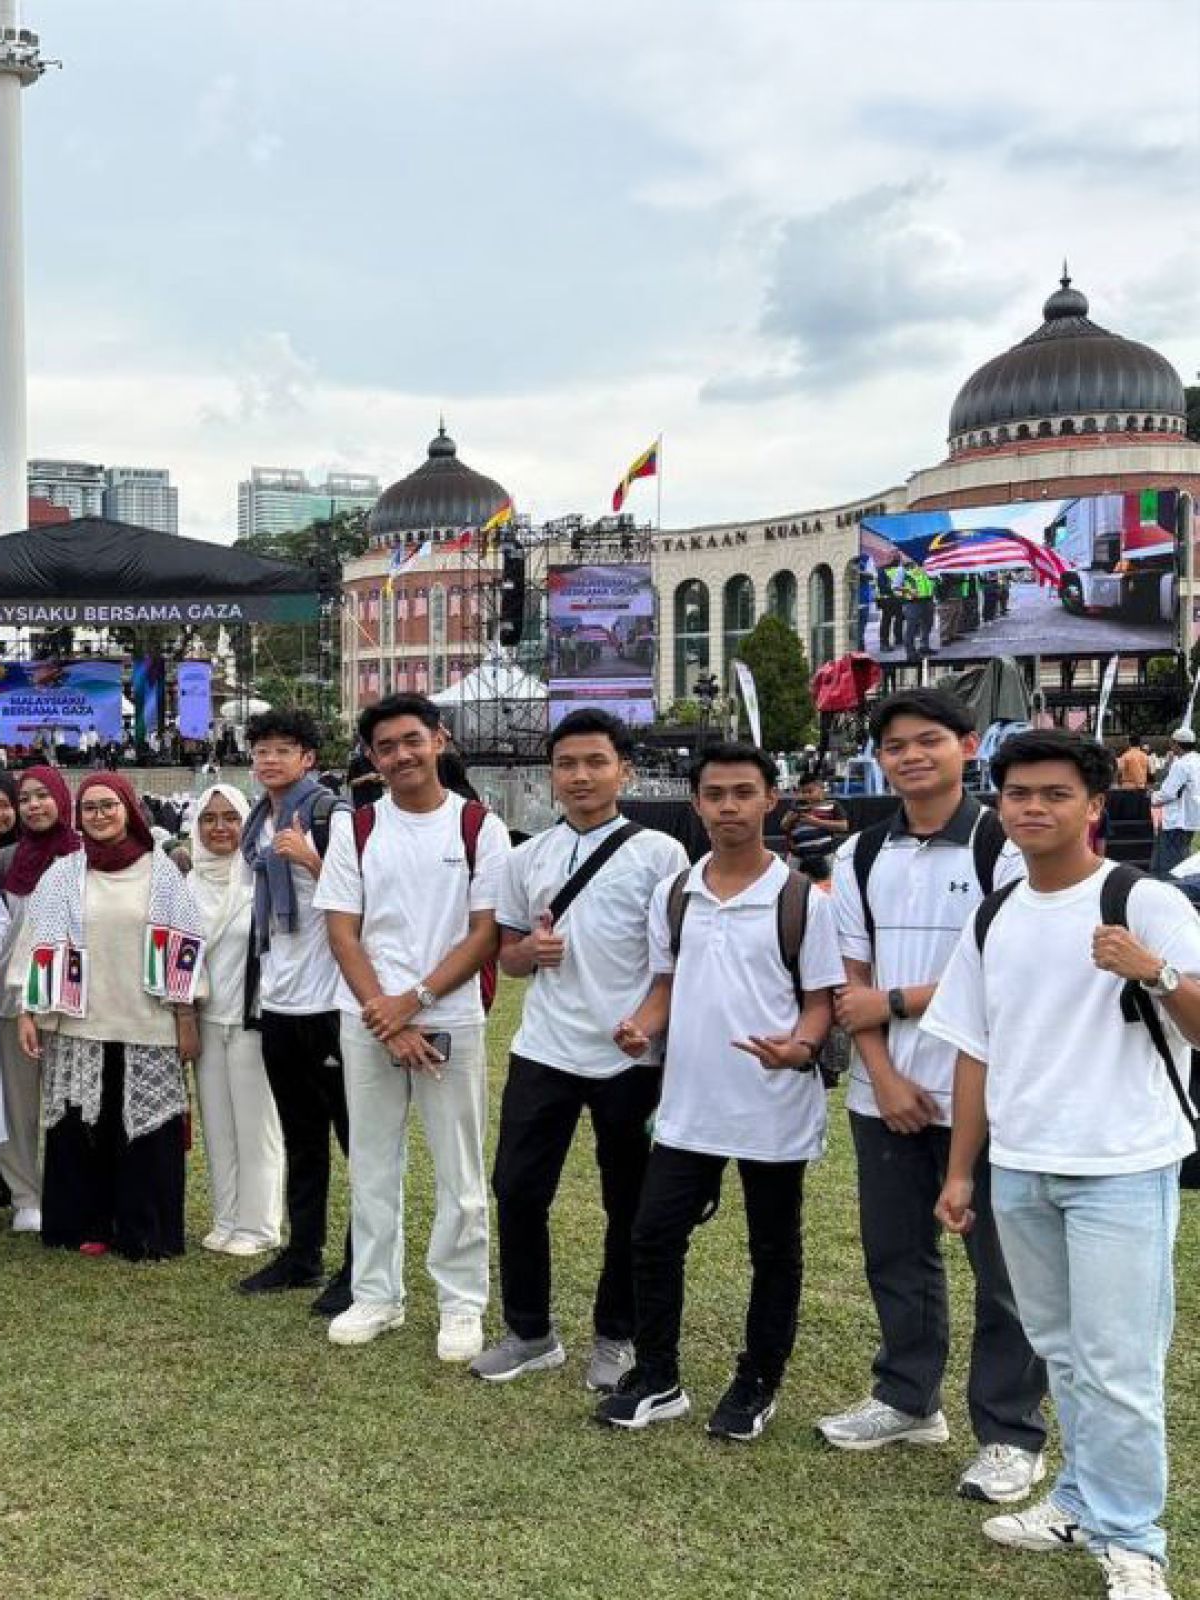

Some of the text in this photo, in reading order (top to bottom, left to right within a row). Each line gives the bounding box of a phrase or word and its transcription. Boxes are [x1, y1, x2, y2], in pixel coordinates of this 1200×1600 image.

[764, 519, 823, 541] KUALA
[83, 605, 182, 621] BERSAMA
[186, 603, 243, 619] GAZA
[2, 706, 94, 716] BERSAMA GAZA
